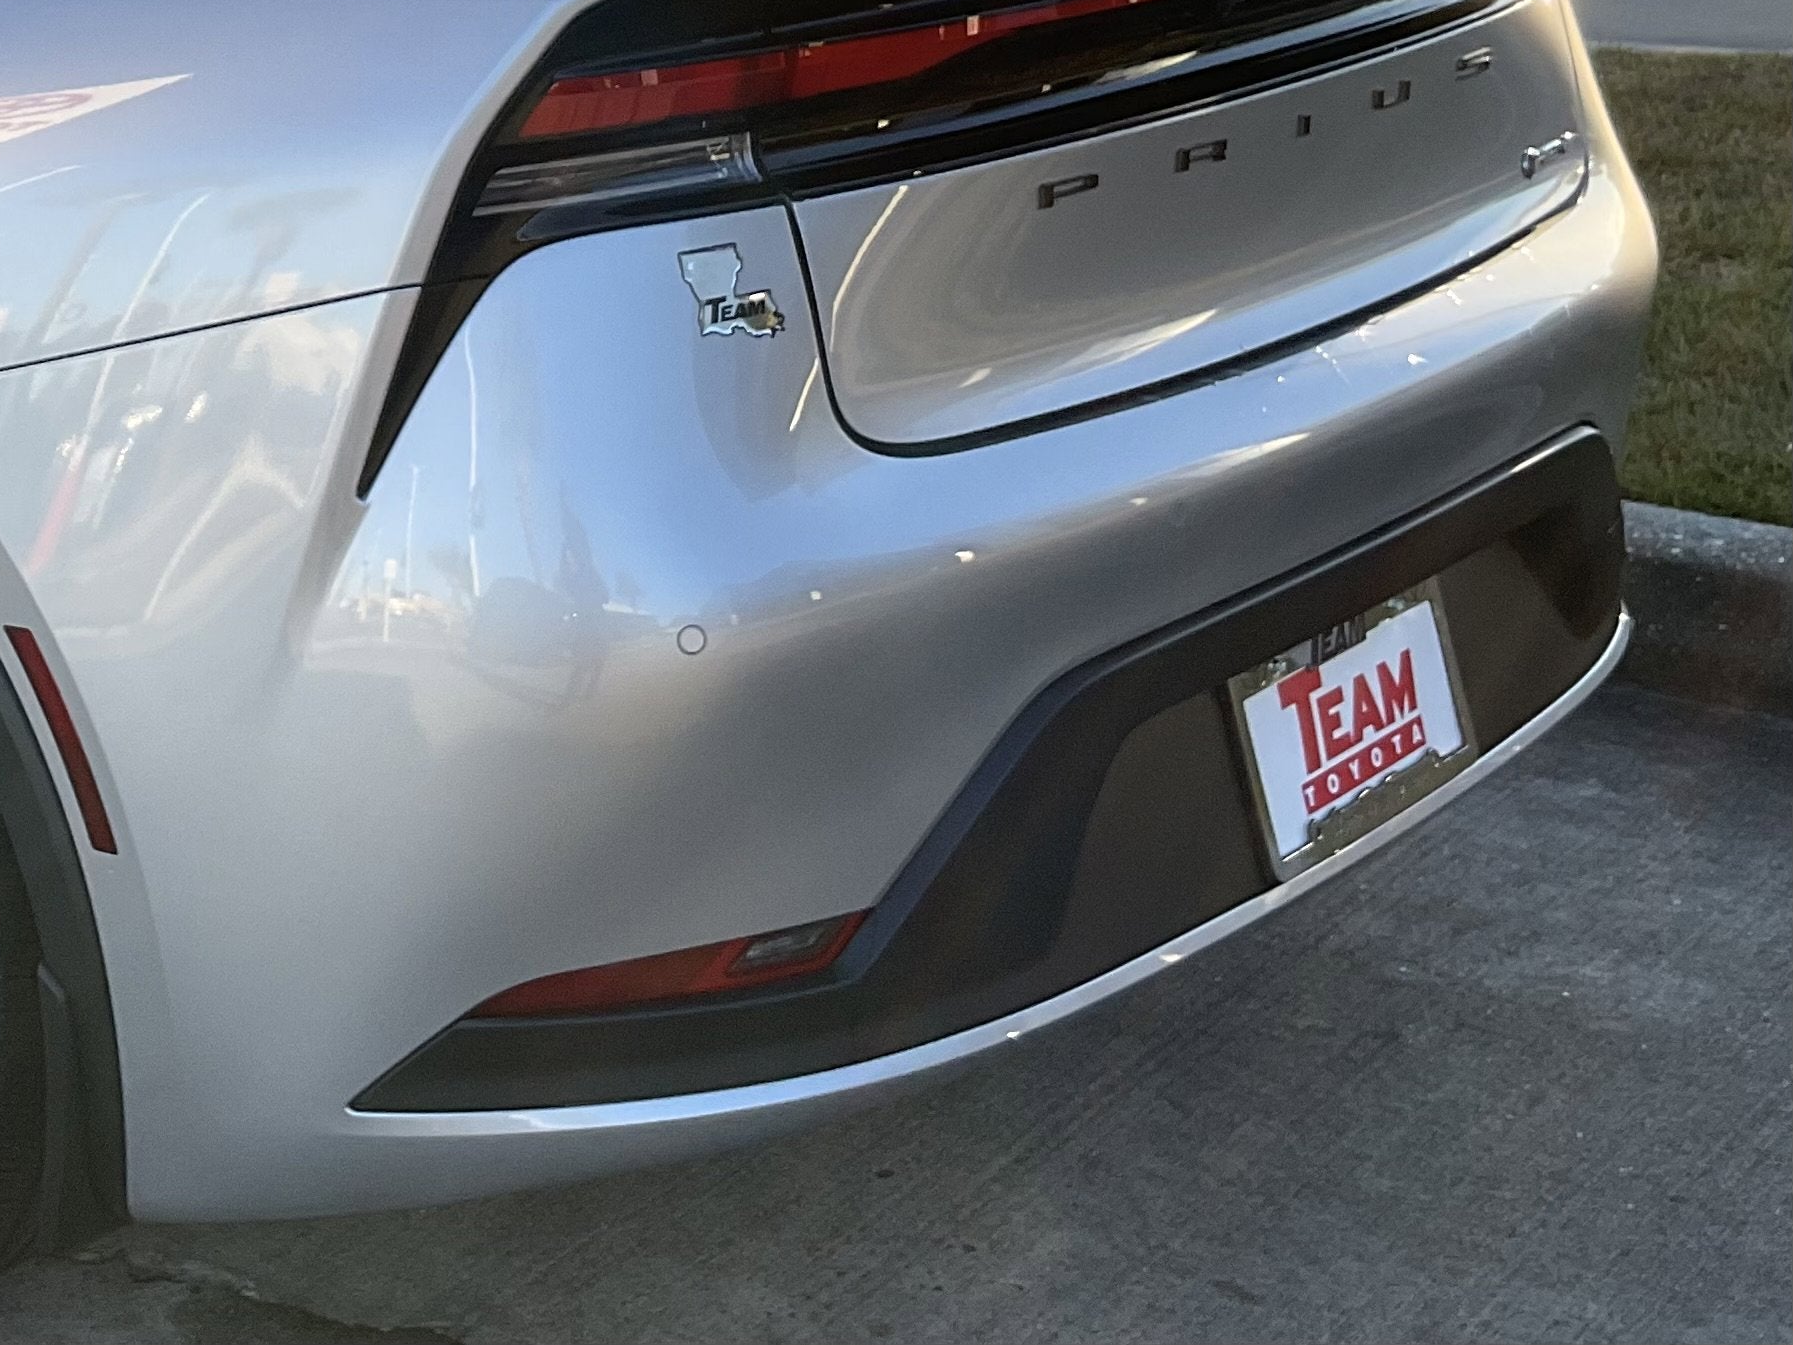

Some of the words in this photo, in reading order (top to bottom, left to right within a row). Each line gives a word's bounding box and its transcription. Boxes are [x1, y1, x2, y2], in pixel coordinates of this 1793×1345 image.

[1037, 46, 1494, 210] PRIUS
[703, 295, 767, 325] TEAM
[1277, 649, 1418, 775] TEAM
[1304, 722, 1423, 808] TOYOTA
